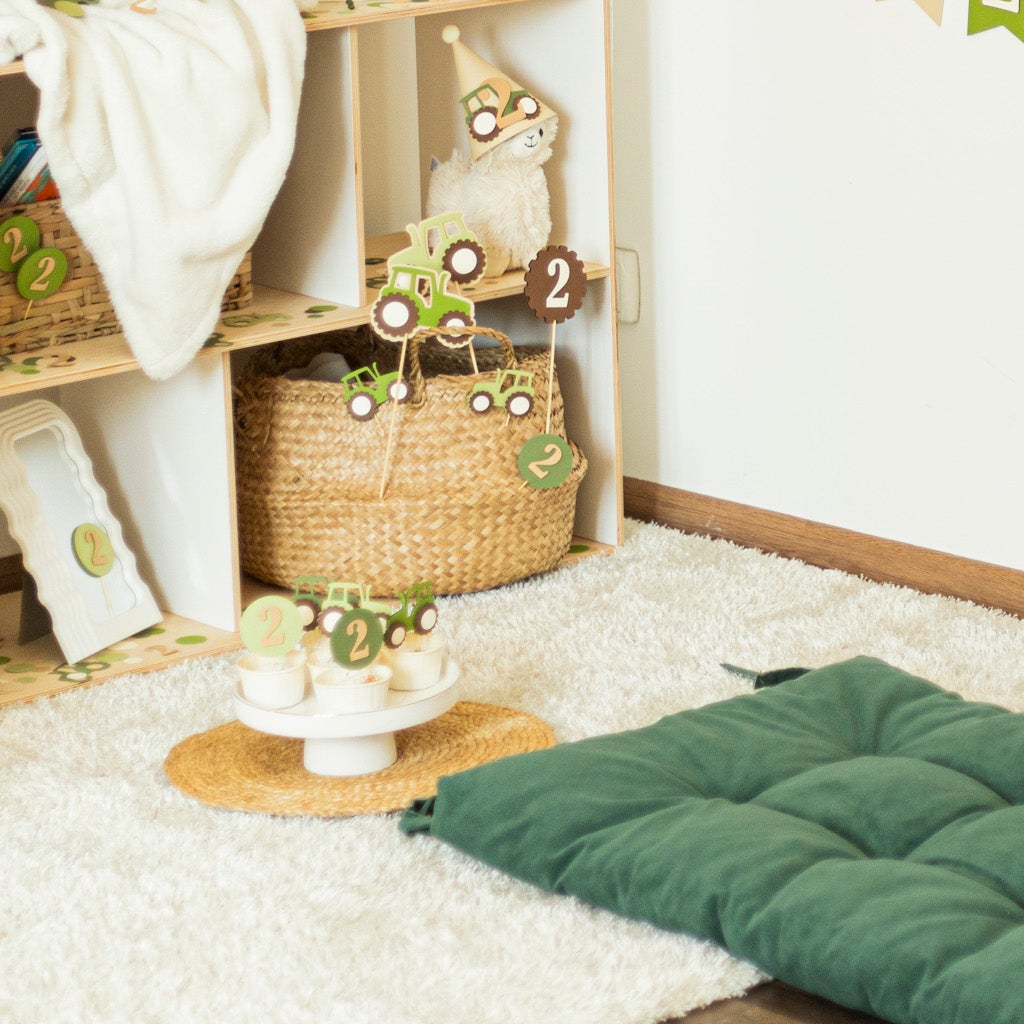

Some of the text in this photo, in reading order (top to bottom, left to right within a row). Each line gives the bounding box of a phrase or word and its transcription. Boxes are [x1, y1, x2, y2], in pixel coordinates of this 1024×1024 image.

[480, 77, 527, 130] 2
[3, 227, 28, 264] 2
[29, 256, 56, 291] 2
[546, 258, 570, 308] 2
[527, 443, 562, 479] 2
[84, 530, 108, 567] 2
[258, 605, 285, 647] 2
[346, 619, 370, 663] 2
